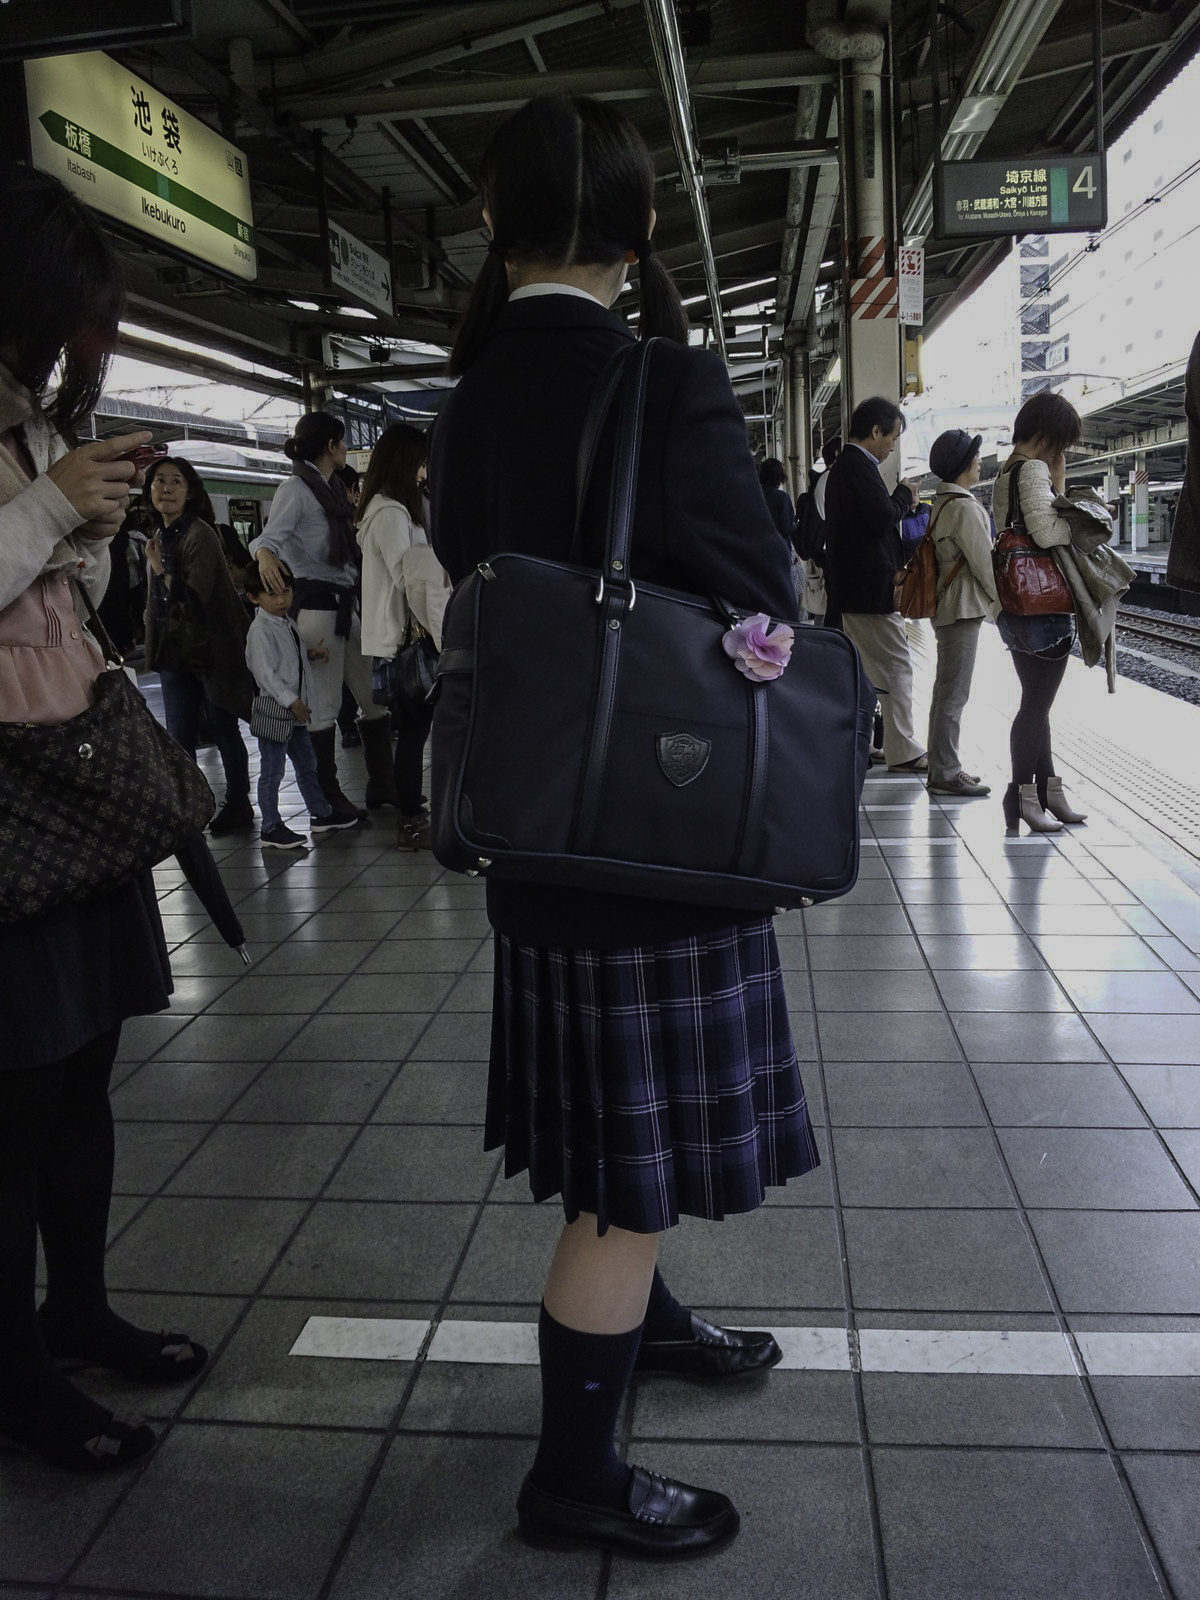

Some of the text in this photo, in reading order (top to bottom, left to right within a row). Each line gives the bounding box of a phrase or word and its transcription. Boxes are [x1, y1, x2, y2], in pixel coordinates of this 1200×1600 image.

[130, 85, 182, 154] 池袋
[64, 121, 92, 158] 板橋
[67, 157, 97, 183] Itabashi
[142, 142, 179, 175] いけぶくろ
[1005, 168, 1047, 184] 埼京線
[1030, 184, 1047, 193] Line
[1072, 165, 1097, 199] 4
[141, 196, 187, 233] Ikebukuro
